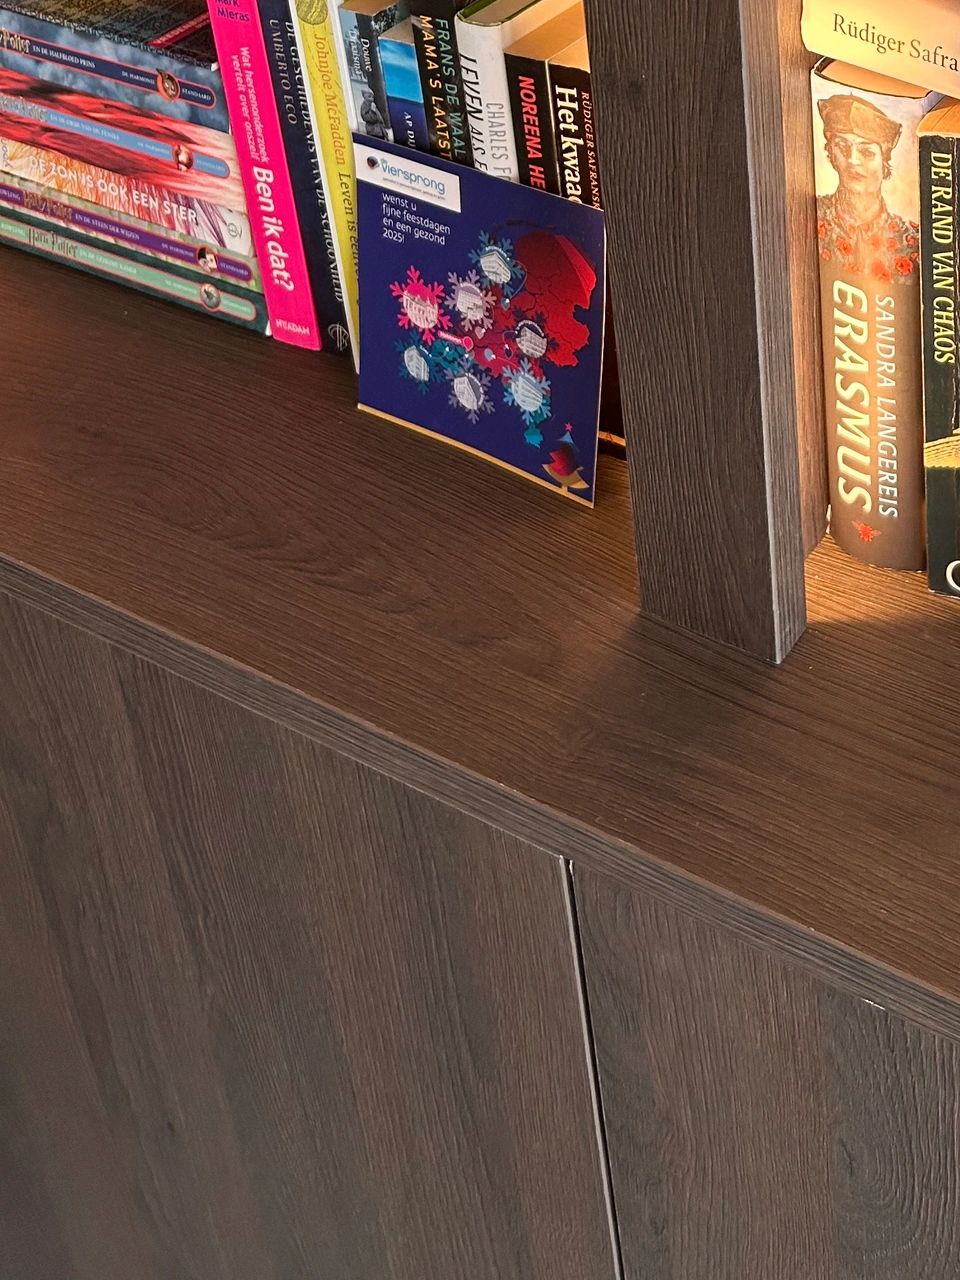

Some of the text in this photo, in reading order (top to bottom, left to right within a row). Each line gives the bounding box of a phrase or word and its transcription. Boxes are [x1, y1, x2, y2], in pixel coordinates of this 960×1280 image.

[217, 8, 249, 21] Mieras
[833, 13, 905, 55] Rüdiger
[419, 15, 442, 95] MAMA'S
[435, 19, 466, 157] FRANS DE WAAL
[460, 53, 484, 124] LEVEN
[244, 69, 269, 163] hersenonderzoek
[314, 33, 346, 165] Johnjoe McFadden
[486, 103, 507, 161] CHARLES
[518, 75, 543, 158] NOREENA
[555, 85, 577, 131] Het
[50, 162, 198, 222] ZON OOK EEN STER
[253, 166, 294, 292] Ben ik dat?
[382, 193, 408, 210] wenst
[402, 209, 450, 235] feestdagen
[414, 224, 445, 244] gezond
[931, 185, 956, 364] RAND VAN CHAOS
[832, 279, 872, 513] ERASMUS
[875, 295, 899, 519] SANDRA LANGEREIS
